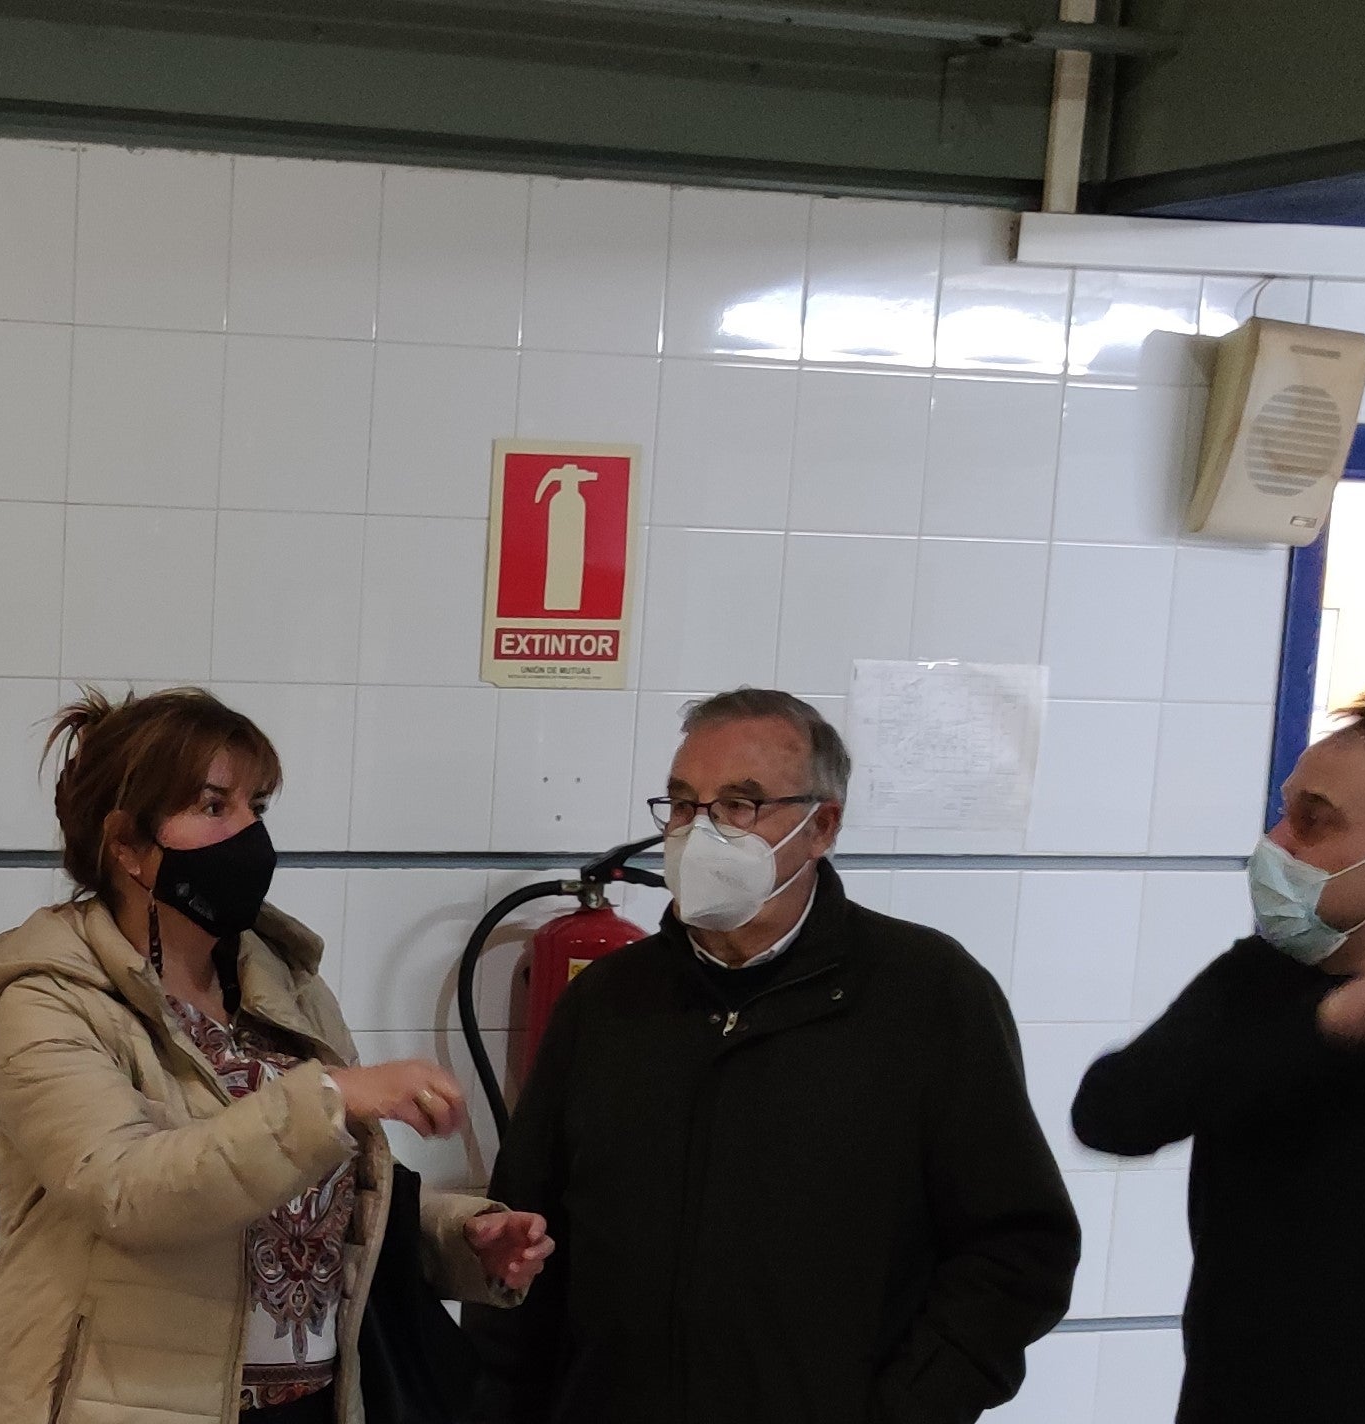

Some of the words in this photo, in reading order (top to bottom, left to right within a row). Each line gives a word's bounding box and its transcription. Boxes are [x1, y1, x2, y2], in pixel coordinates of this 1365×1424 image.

[500, 633, 614, 656] EXTINTOR
[547, 666, 557, 674] DE
[559, 666, 591, 674] MUTUAS
